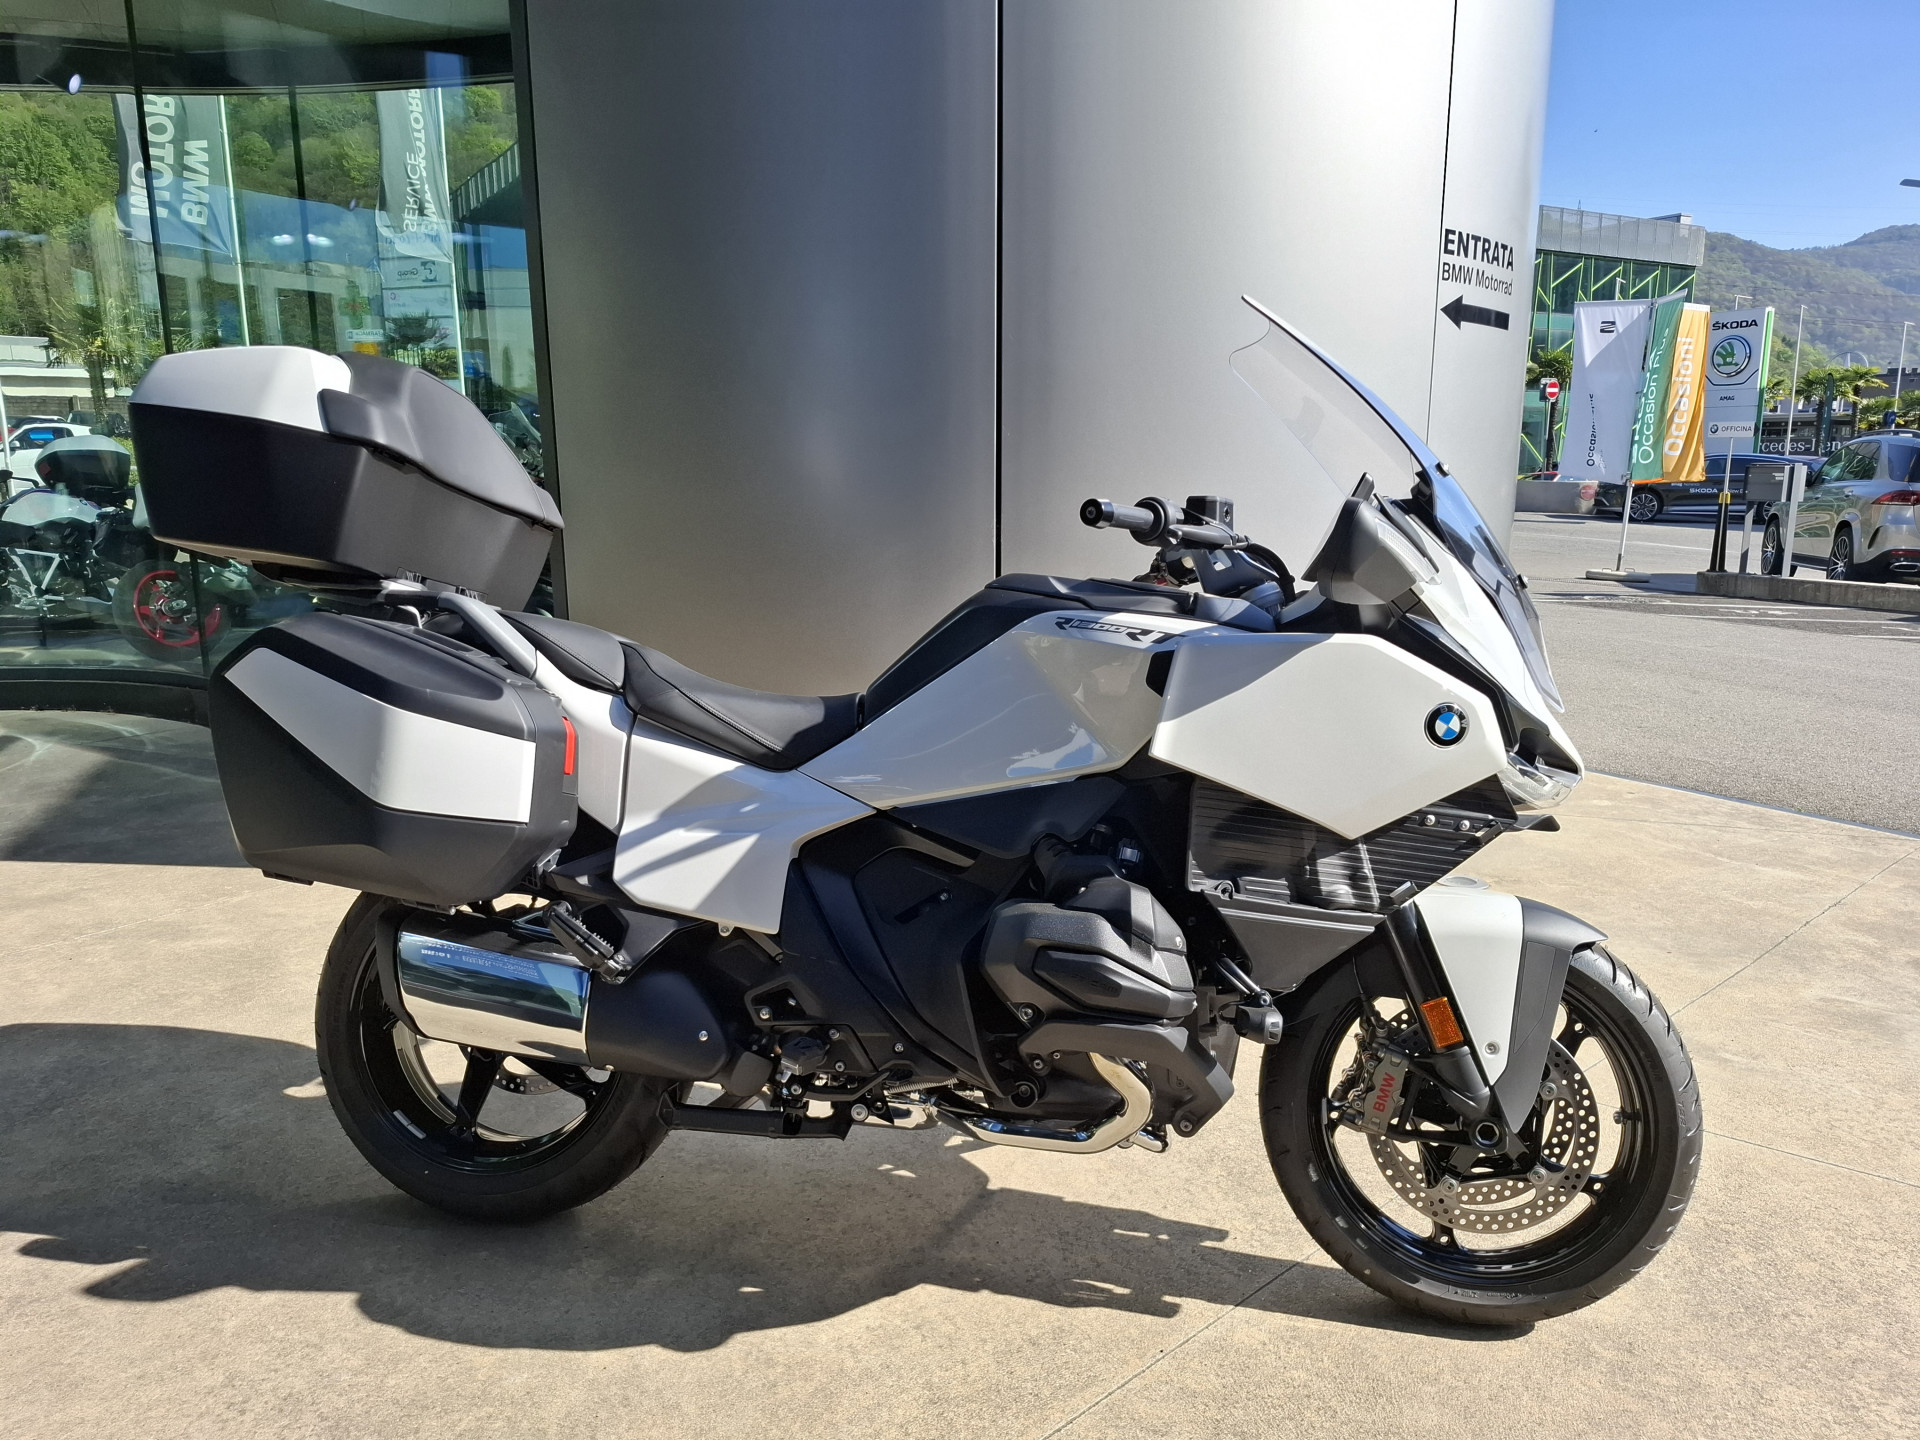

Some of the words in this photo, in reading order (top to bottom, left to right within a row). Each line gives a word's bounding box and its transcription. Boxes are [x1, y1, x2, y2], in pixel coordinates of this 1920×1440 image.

[1443, 228, 1514, 272] ENTRATA
[1441, 261, 1474, 286] BMW
[1475, 268, 1514, 296] Motorrad
[1712, 319, 1758, 331] ŠKODA
[1664, 337, 1695, 456] Occasioni
[1638, 374, 1659, 464] Occasion
[1373, 1072, 1396, 1112] BMW
